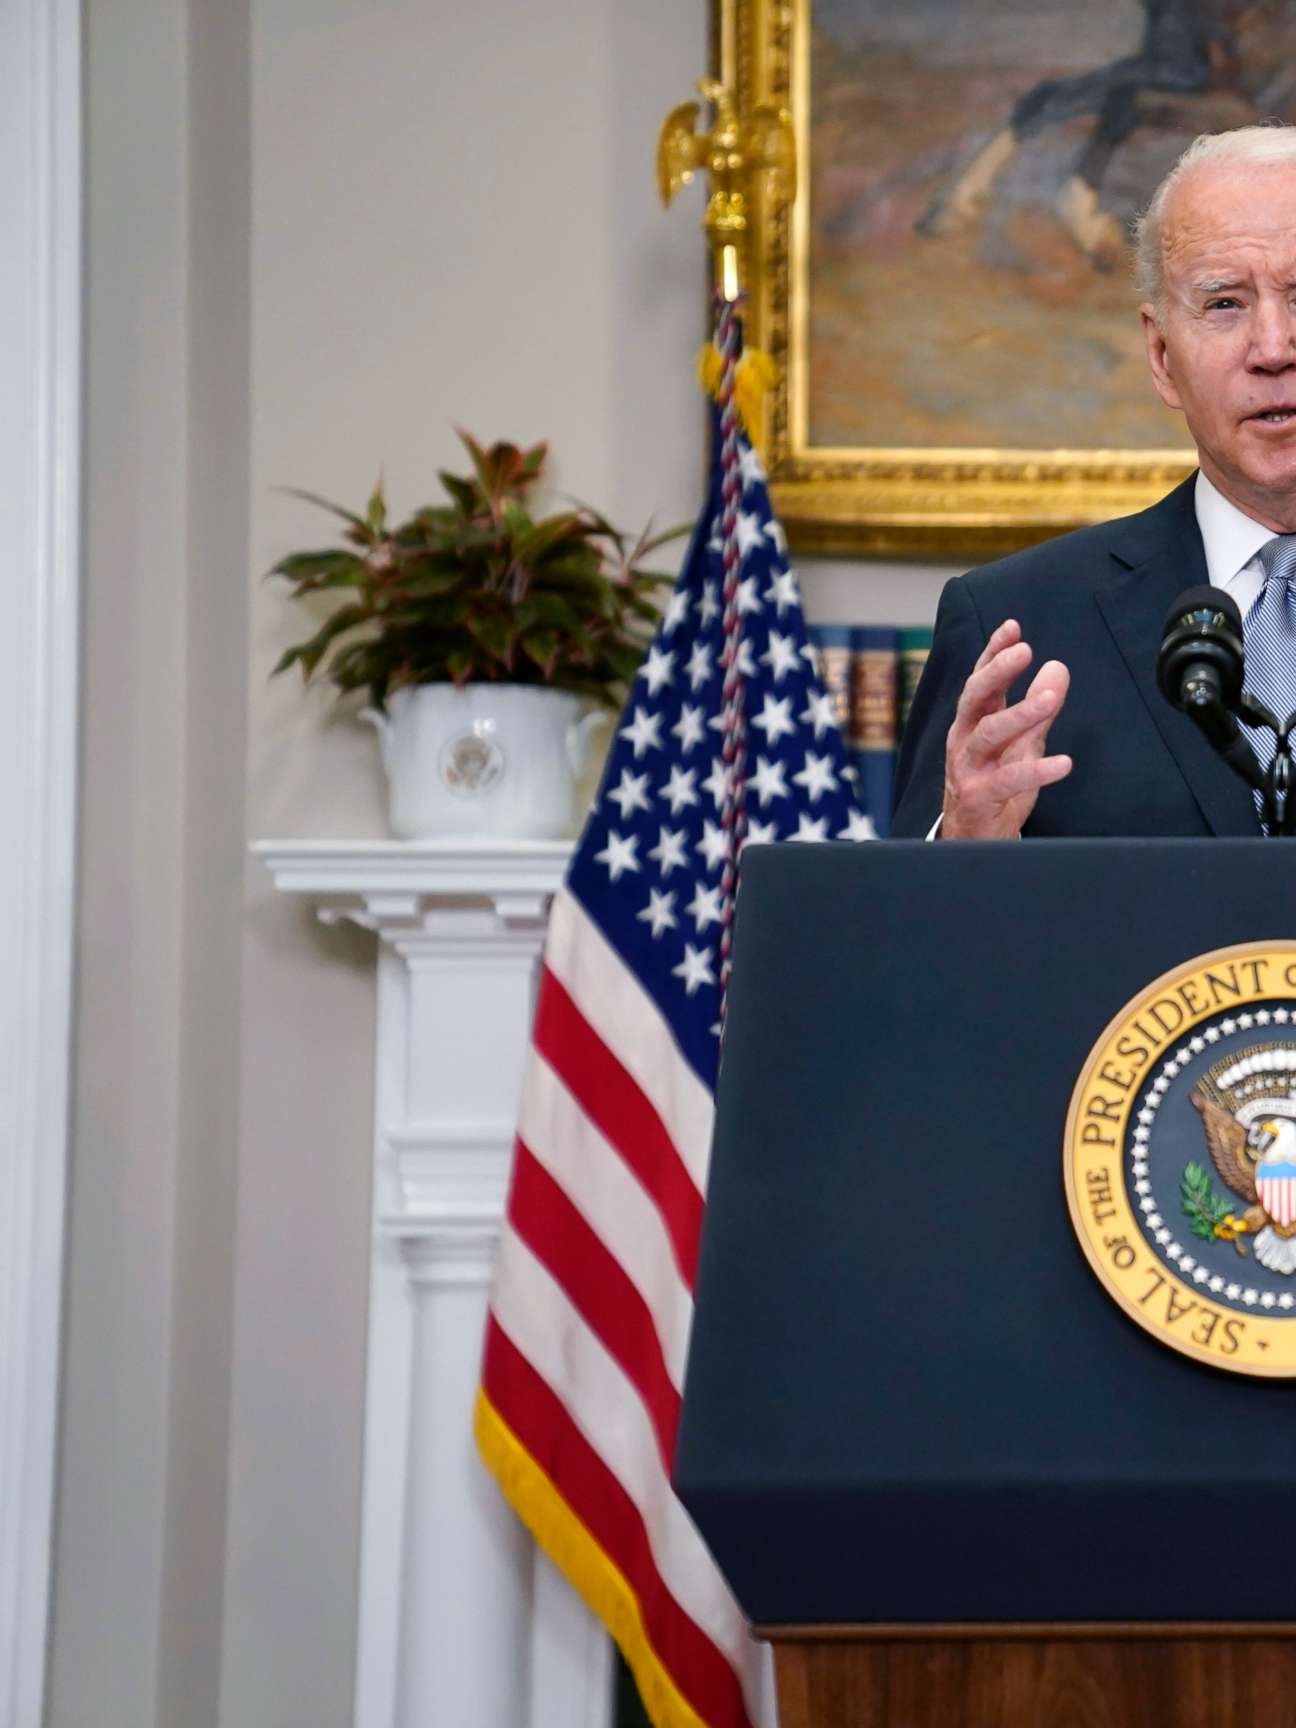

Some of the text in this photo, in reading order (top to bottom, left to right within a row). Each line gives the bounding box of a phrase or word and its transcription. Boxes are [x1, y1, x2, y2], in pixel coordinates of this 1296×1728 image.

[1082, 960, 1269, 1149] PRESIDENT
[1086, 1166, 1118, 1227] THE
[1103, 1234, 1137, 1270] OF
[1138, 1266, 1246, 1353] SEAL
